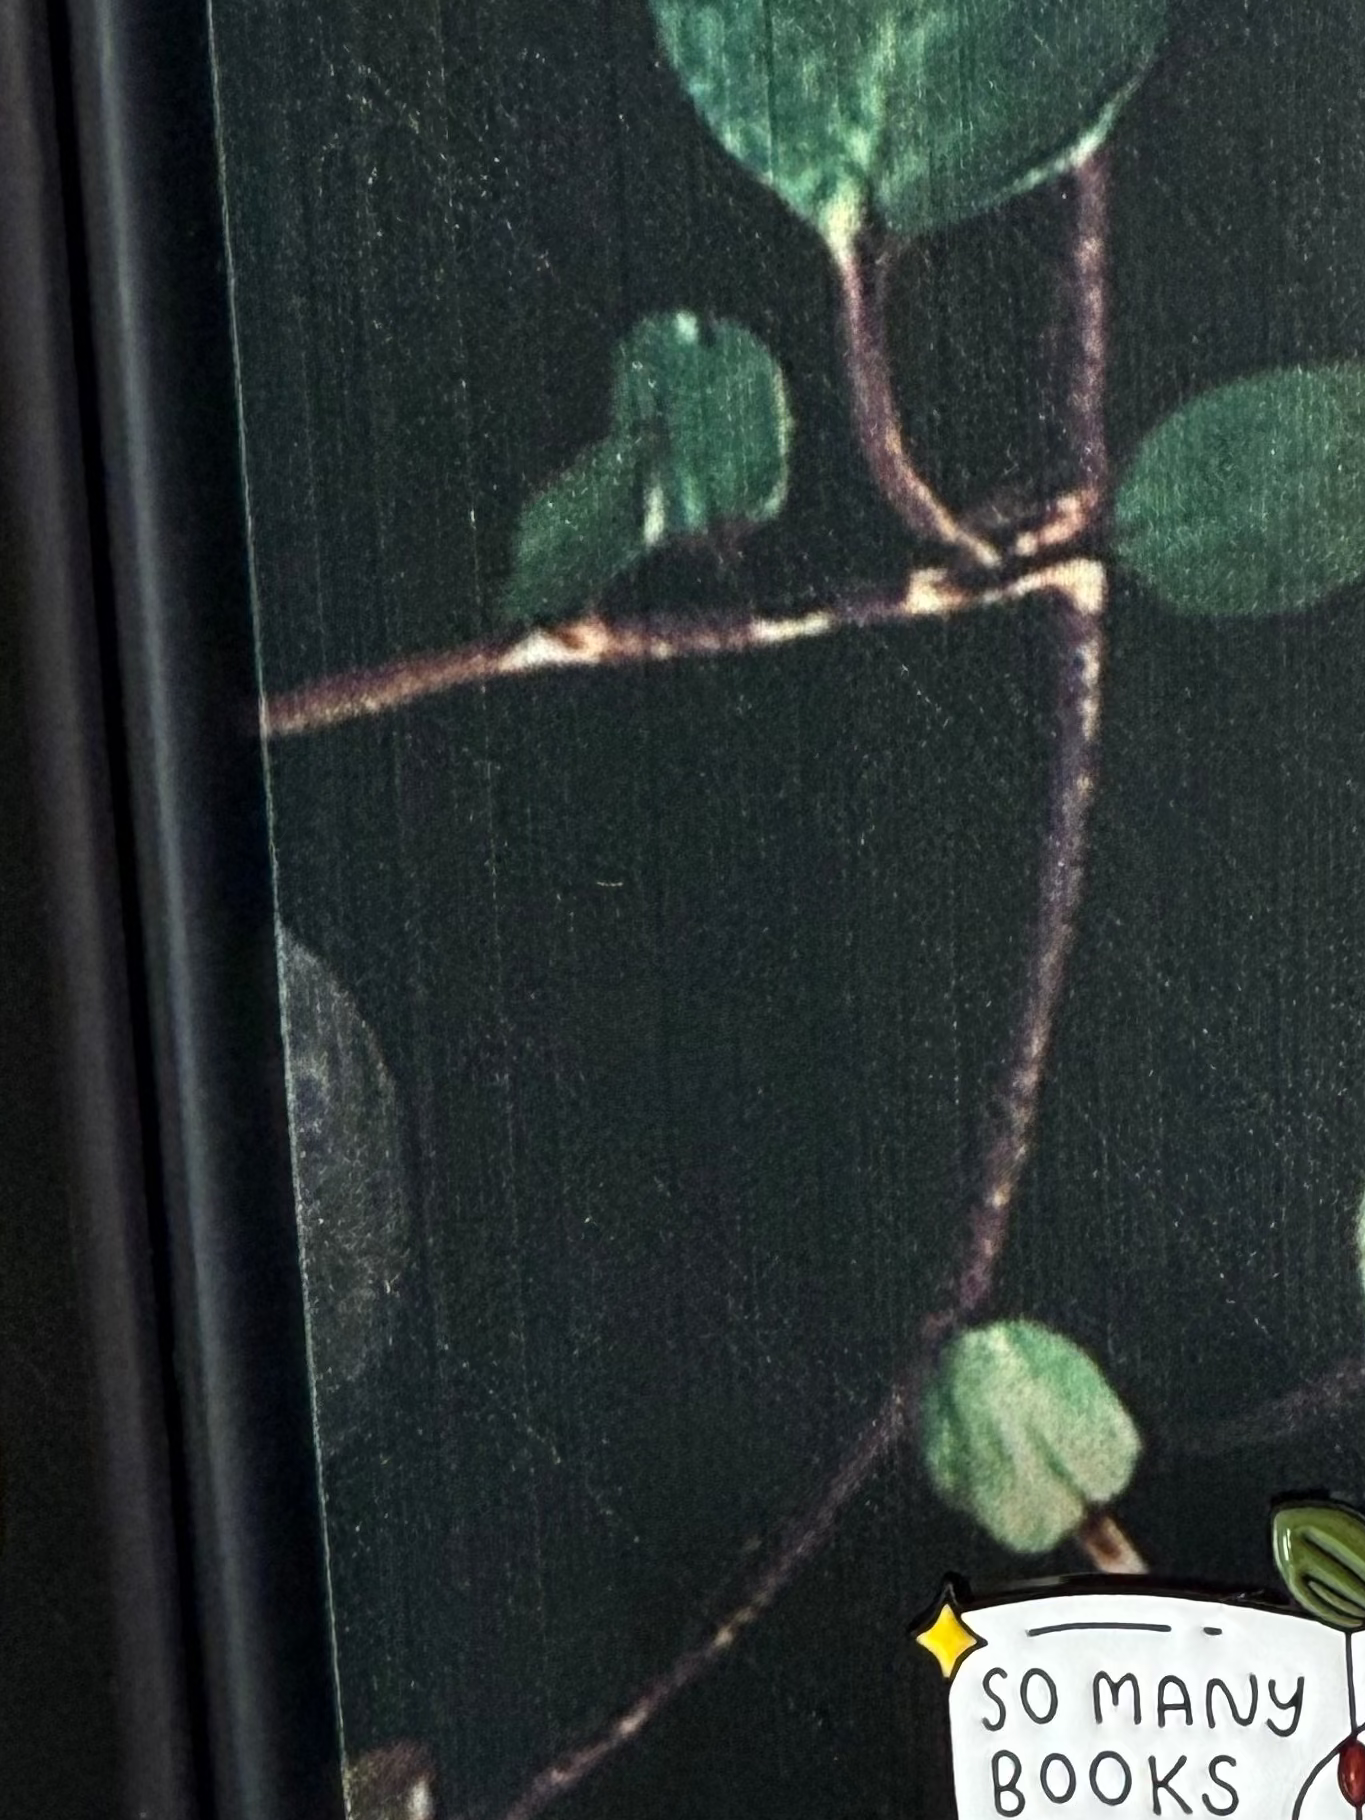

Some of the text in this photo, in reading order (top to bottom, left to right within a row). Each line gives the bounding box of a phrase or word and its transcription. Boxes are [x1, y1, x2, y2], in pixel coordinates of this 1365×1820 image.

[982, 1667, 1305, 1738] SO MANY
[991, 1749, 1240, 1818] BOOKS
